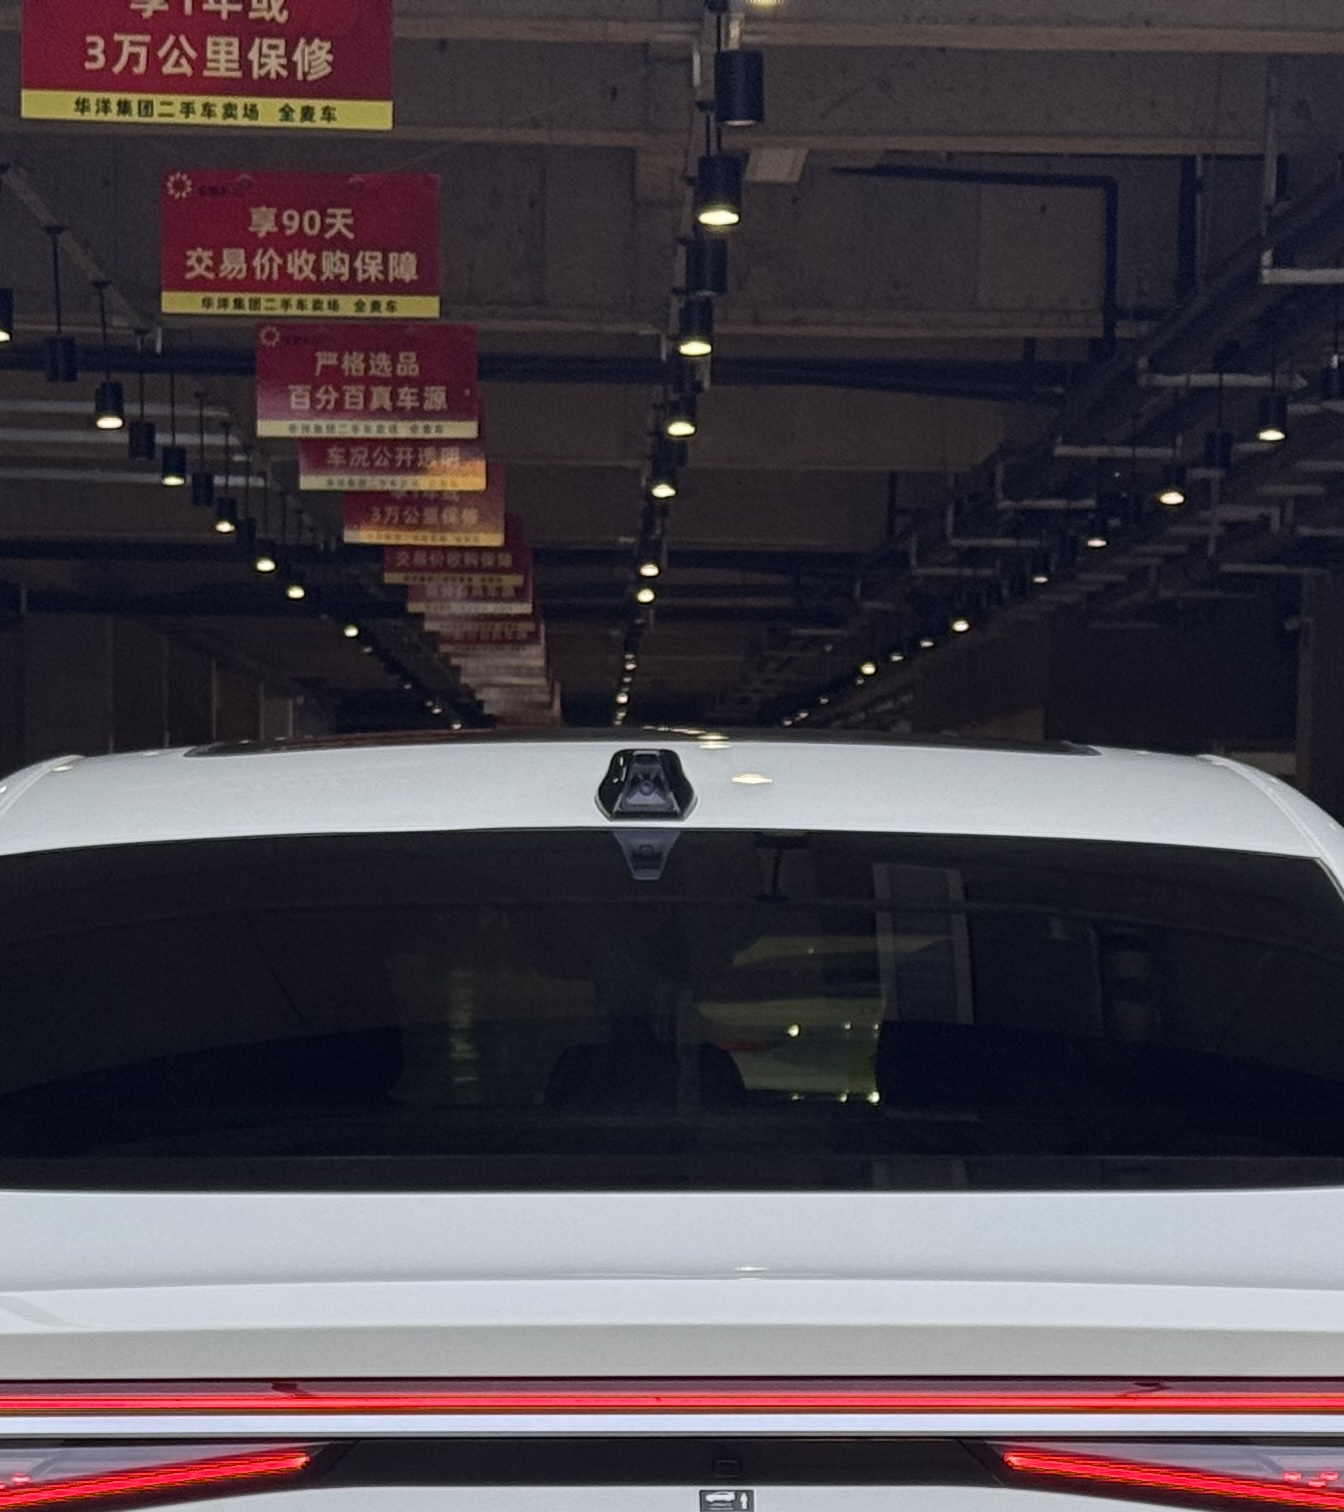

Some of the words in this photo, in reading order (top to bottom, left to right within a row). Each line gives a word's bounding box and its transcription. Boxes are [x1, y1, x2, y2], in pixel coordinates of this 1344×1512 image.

[84, 33, 335, 82] 3万公里保修
[74, 96, 260, 121] 华洋集团二手车卖场
[278, 102, 338, 123] 全麦车
[248, 206, 355, 240] 享90天
[185, 247, 419, 284] 交易价收购保障
[314, 351, 420, 377] 严格选品
[288, 384, 448, 412] 百分百真车源
